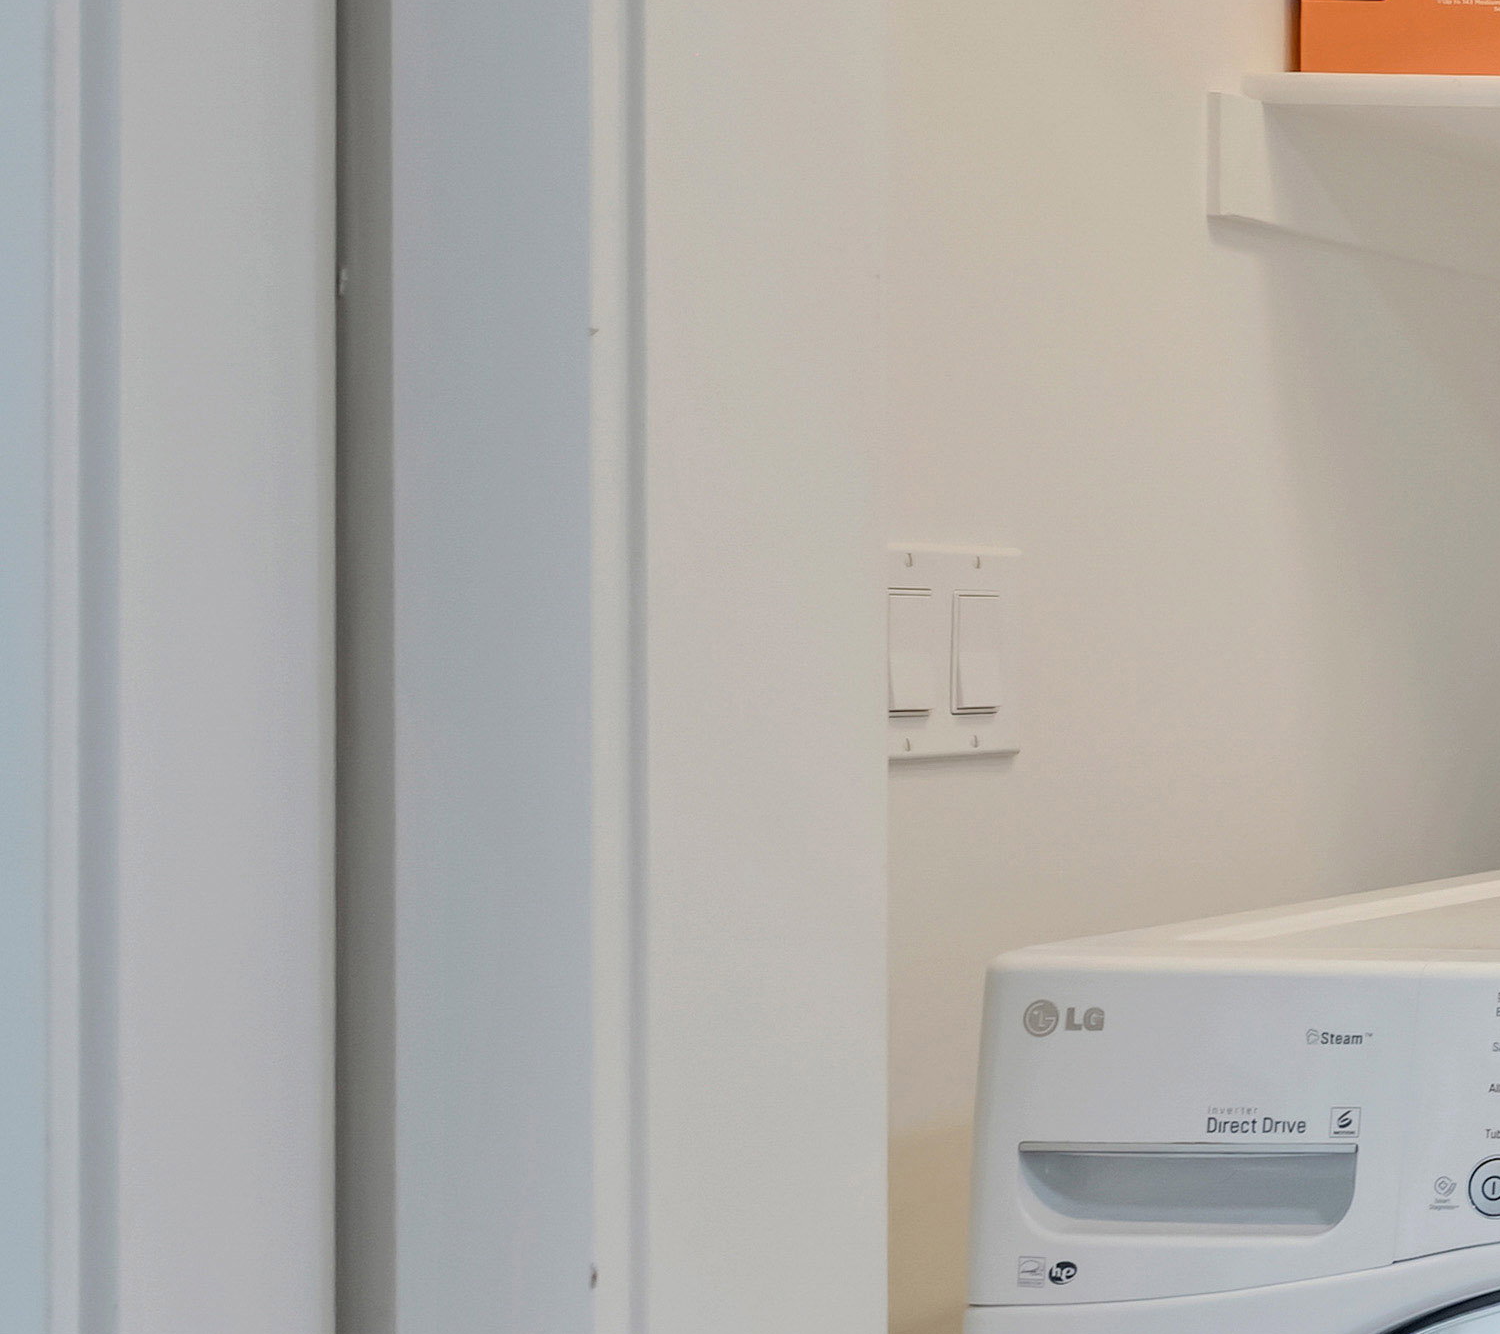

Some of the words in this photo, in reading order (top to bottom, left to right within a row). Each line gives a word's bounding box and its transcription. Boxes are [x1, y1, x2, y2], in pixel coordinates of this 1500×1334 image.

[1064, 1007, 1105, 1031] LG
[1206, 1117, 1257, 1134] Direct
[1262, 1117, 1306, 1133] Drive
